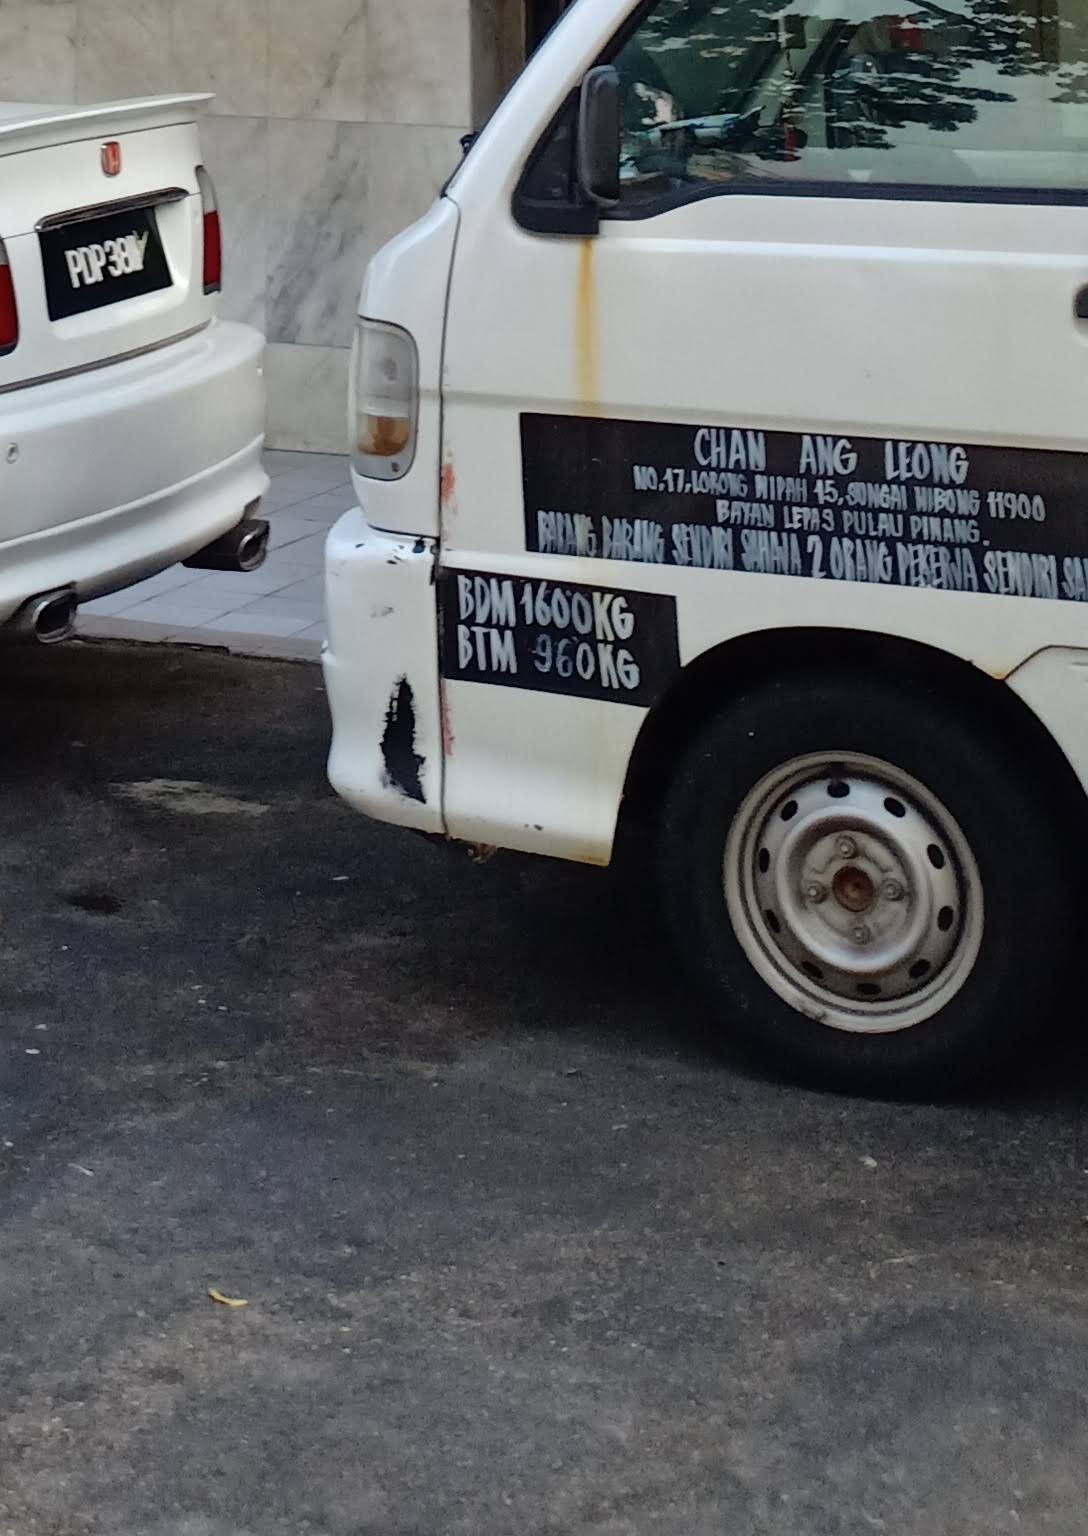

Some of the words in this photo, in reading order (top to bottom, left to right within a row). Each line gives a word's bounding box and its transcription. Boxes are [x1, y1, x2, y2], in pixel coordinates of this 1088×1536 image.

[694, 428, 766, 471] CHAN
[799, 434, 858, 476] ANG
[884, 439, 970, 484] LEONG
[783, 503, 836, 533] LEPAS
[842, 509, 904, 538] PULAU
[986, 490, 1047, 522] 11900
[806, 534, 826, 579] 2
[830, 536, 893, 583] ORANG
[457, 575, 517, 627] BDM
[519, 580, 635, 641] 1600KG
[457, 624, 518, 674] BTM
